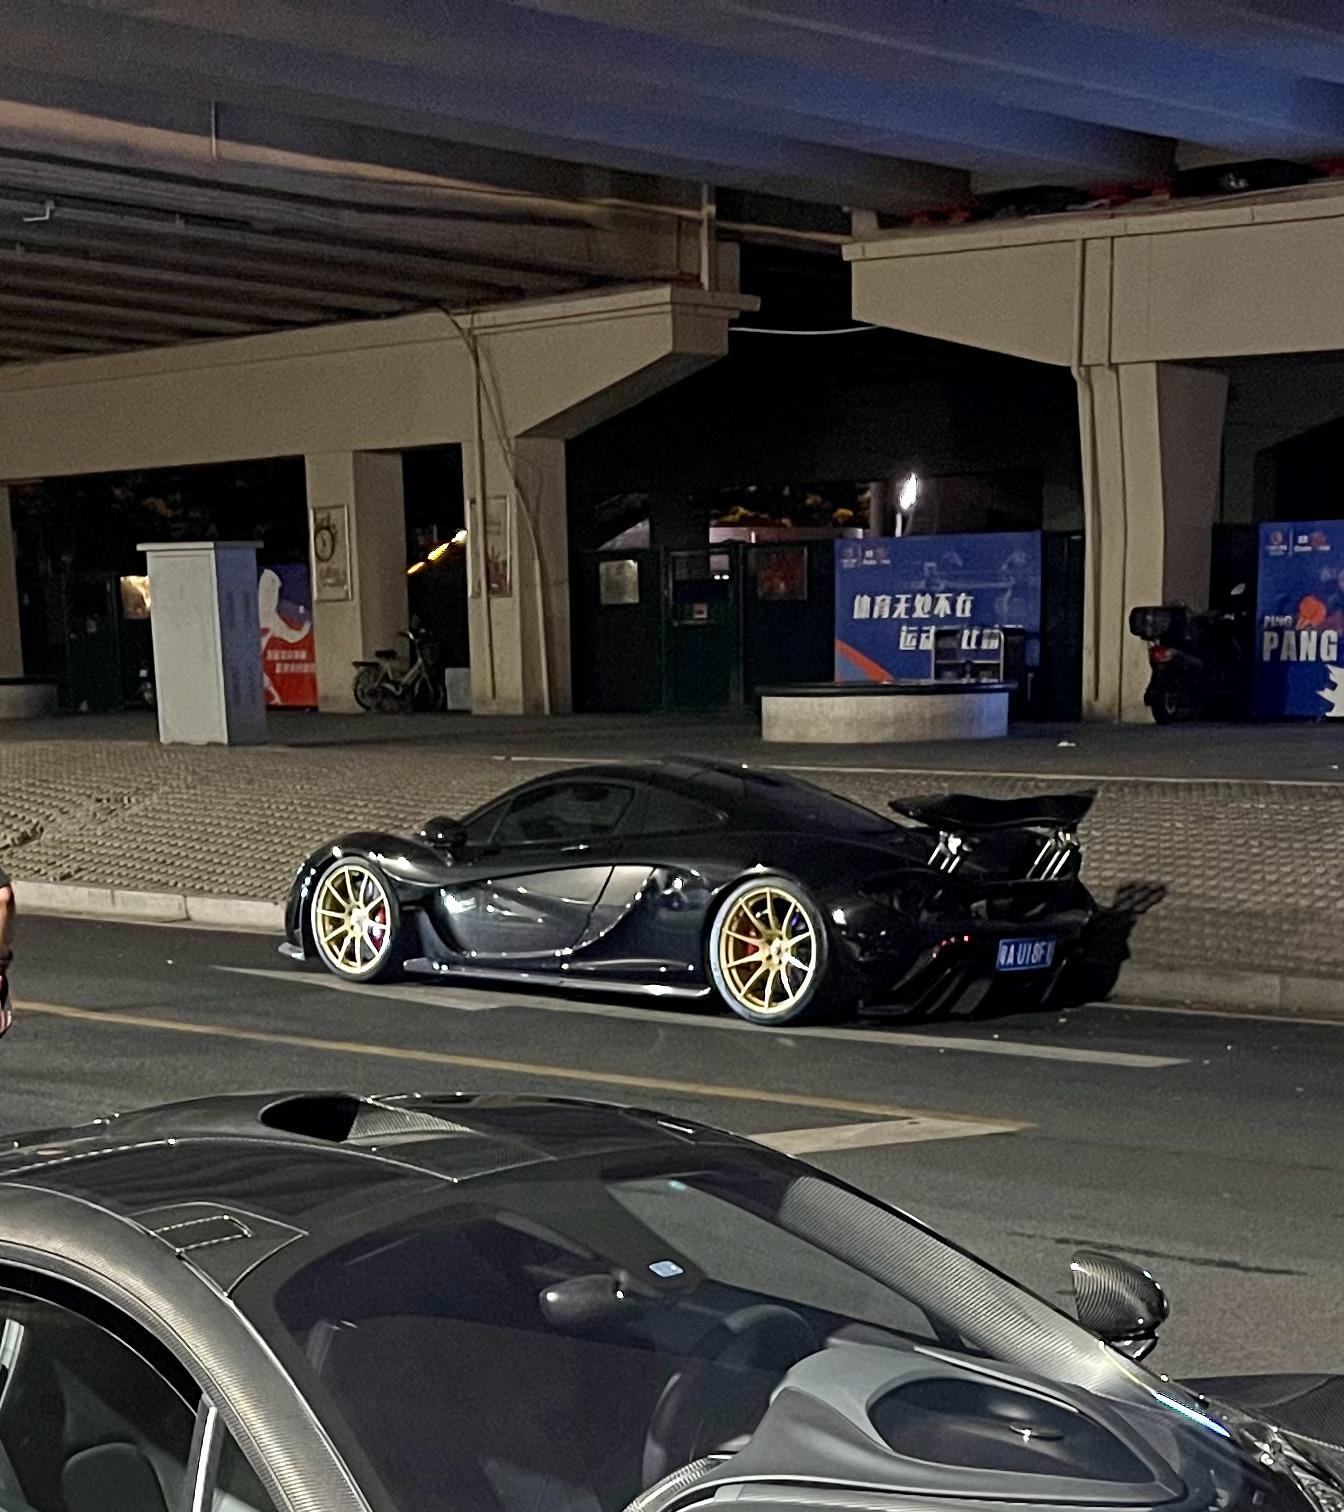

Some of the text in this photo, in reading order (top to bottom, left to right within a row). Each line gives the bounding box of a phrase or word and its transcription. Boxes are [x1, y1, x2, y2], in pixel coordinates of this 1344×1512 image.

[853, 593, 975, 619] 体育无处不在
[1262, 630, 1338, 662] PANG
